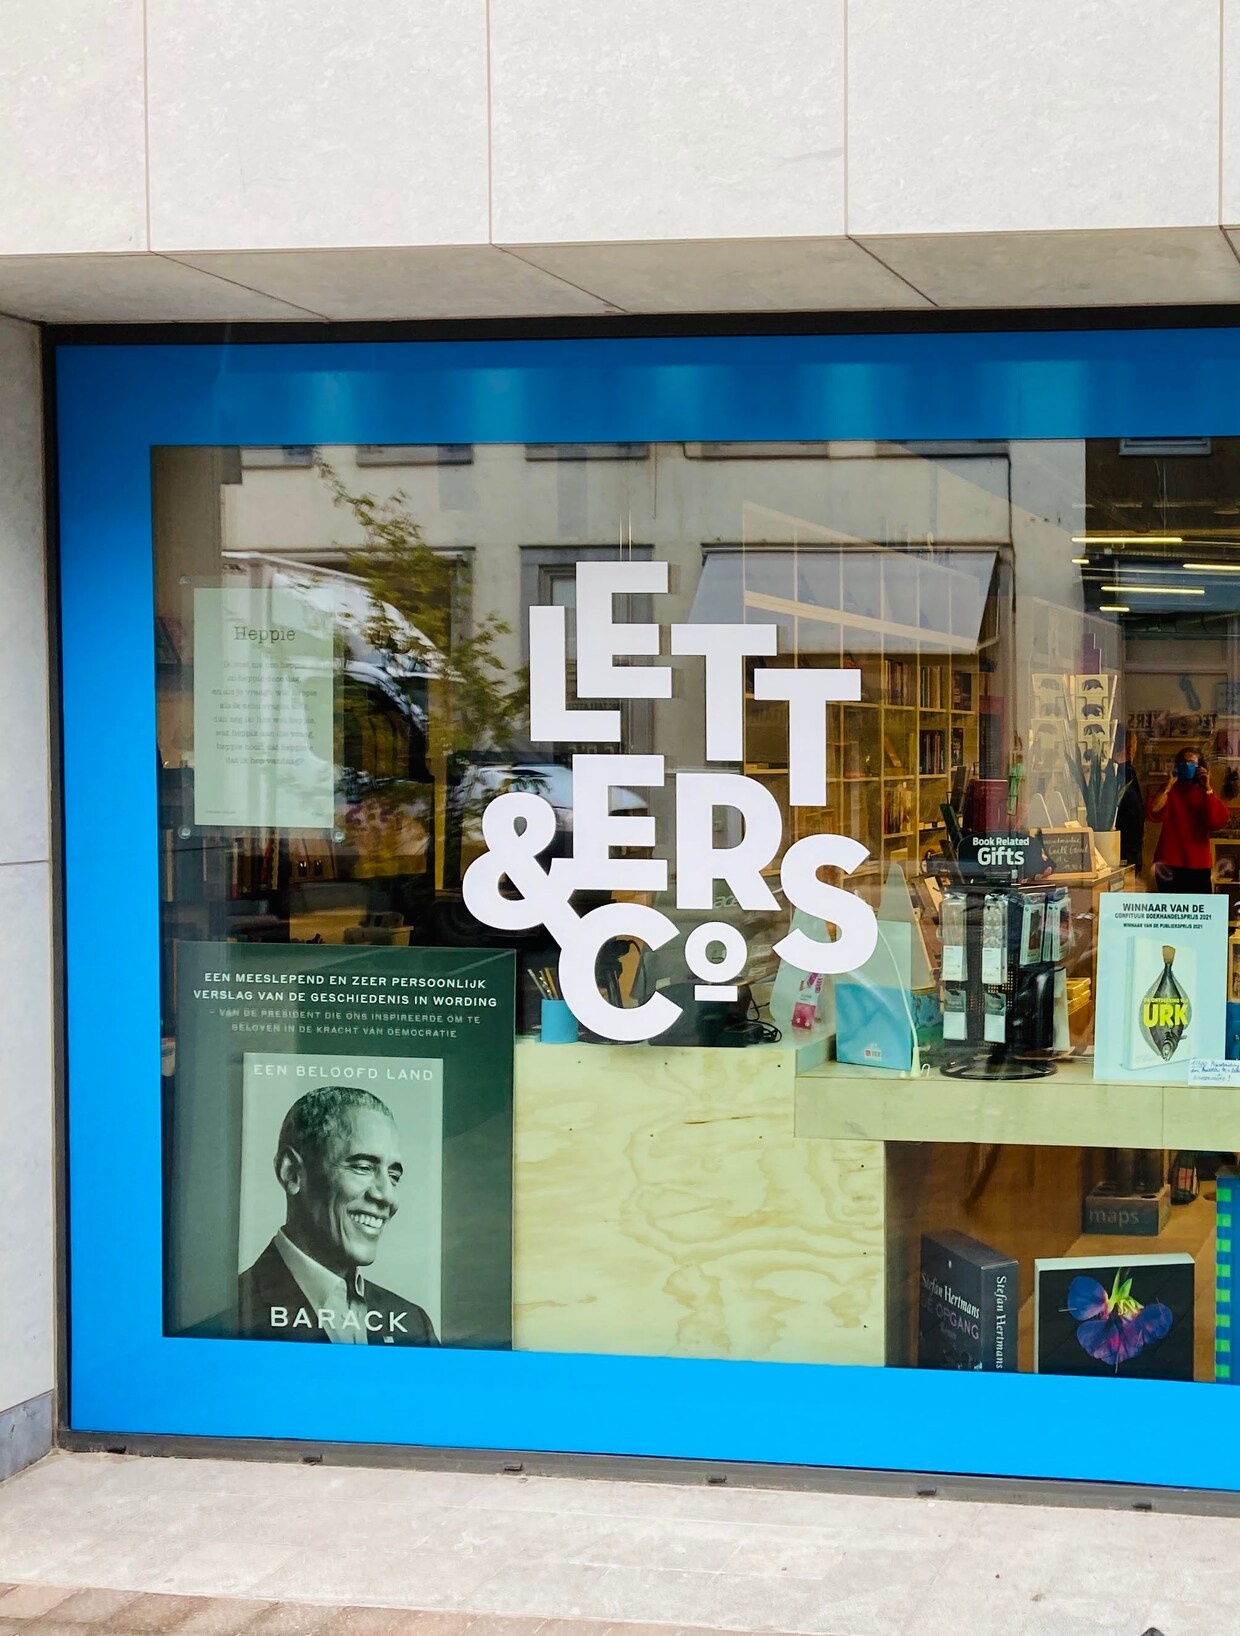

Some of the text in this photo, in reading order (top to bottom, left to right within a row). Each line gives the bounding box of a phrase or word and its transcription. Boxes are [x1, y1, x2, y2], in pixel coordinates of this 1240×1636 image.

[234, 626, 295, 643] Heppie
[529, 561, 862, 807] LETT
[972, 837, 1029, 846] Book Related
[572, 754, 879, 974] ERS
[977, 846, 1025, 866] Gifts
[1122, 903, 1204, 913] WINNAAR VAN DE
[204, 972, 486, 989] EEN MEESLEPEND EN ZEER PERSOONLIJK
[193, 990, 497, 1007] VERSLAG VAN DE GESCHIEDENIS IN WORDING
[219, 1008, 240, 1017] VAN
[243, 1009, 257, 1017] DE
[261, 1009, 320, 1019] PRESIDENT
[325, 1011, 342, 1020] DIE
[346, 1012, 367, 1020] ONS
[371, 1013, 443, 1023] INSPIREERDE
[447, 1015, 463, 1023] OM
[467, 1016, 480, 1024] TE
[1143, 1004, 1188, 1027] URK
[231, 1023, 457, 1038] BELOVEN IN DE KRACHT VAN DEMOCRATIE
[253, 1064, 433, 1081] EEN BELOOFD LAND
[1088, 1207, 1139, 1228] maps
[921, 1272, 980, 1319] Stefan Hertmans
[270, 1306, 408, 1333] BARACK
[936, 1303, 980, 1340] OPGANG
[994, 1275, 1007, 1369] Stefan Hertmans
